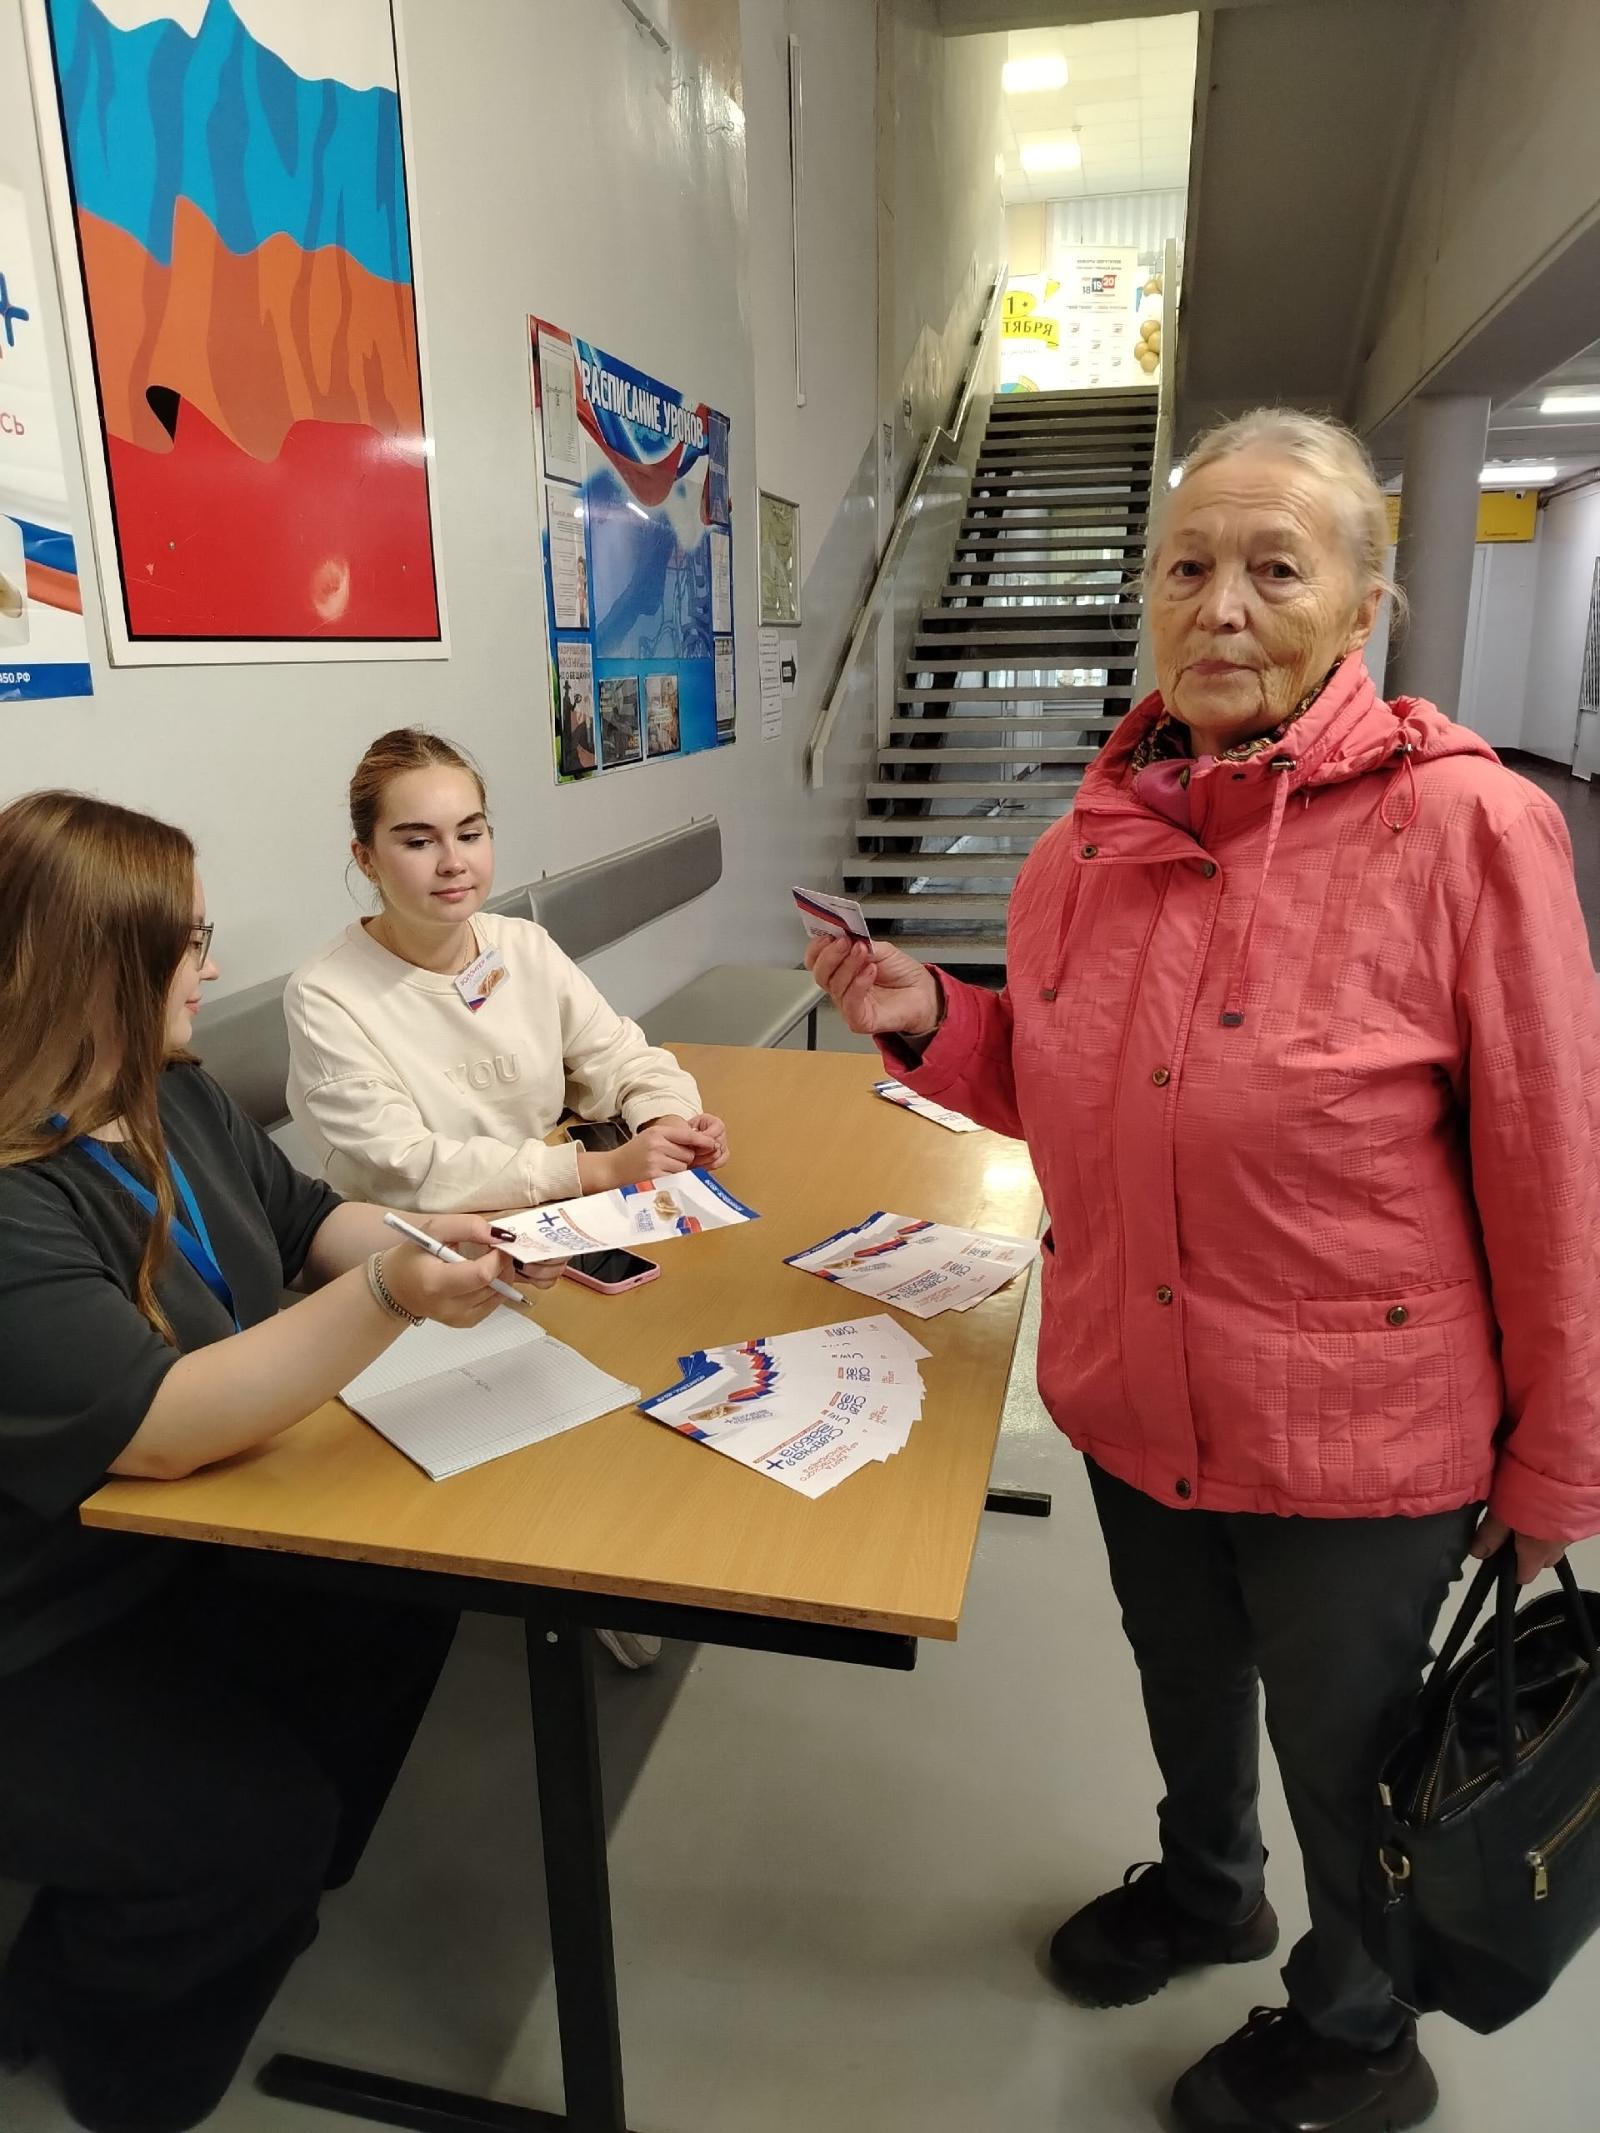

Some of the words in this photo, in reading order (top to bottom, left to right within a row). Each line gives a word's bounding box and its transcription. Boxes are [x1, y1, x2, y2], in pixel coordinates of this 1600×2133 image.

[580, 359, 662, 433] РАСПИСАНИЕ
[663, 400, 704, 449] УРОКОВ
[443, 1053, 521, 1094] YOU
